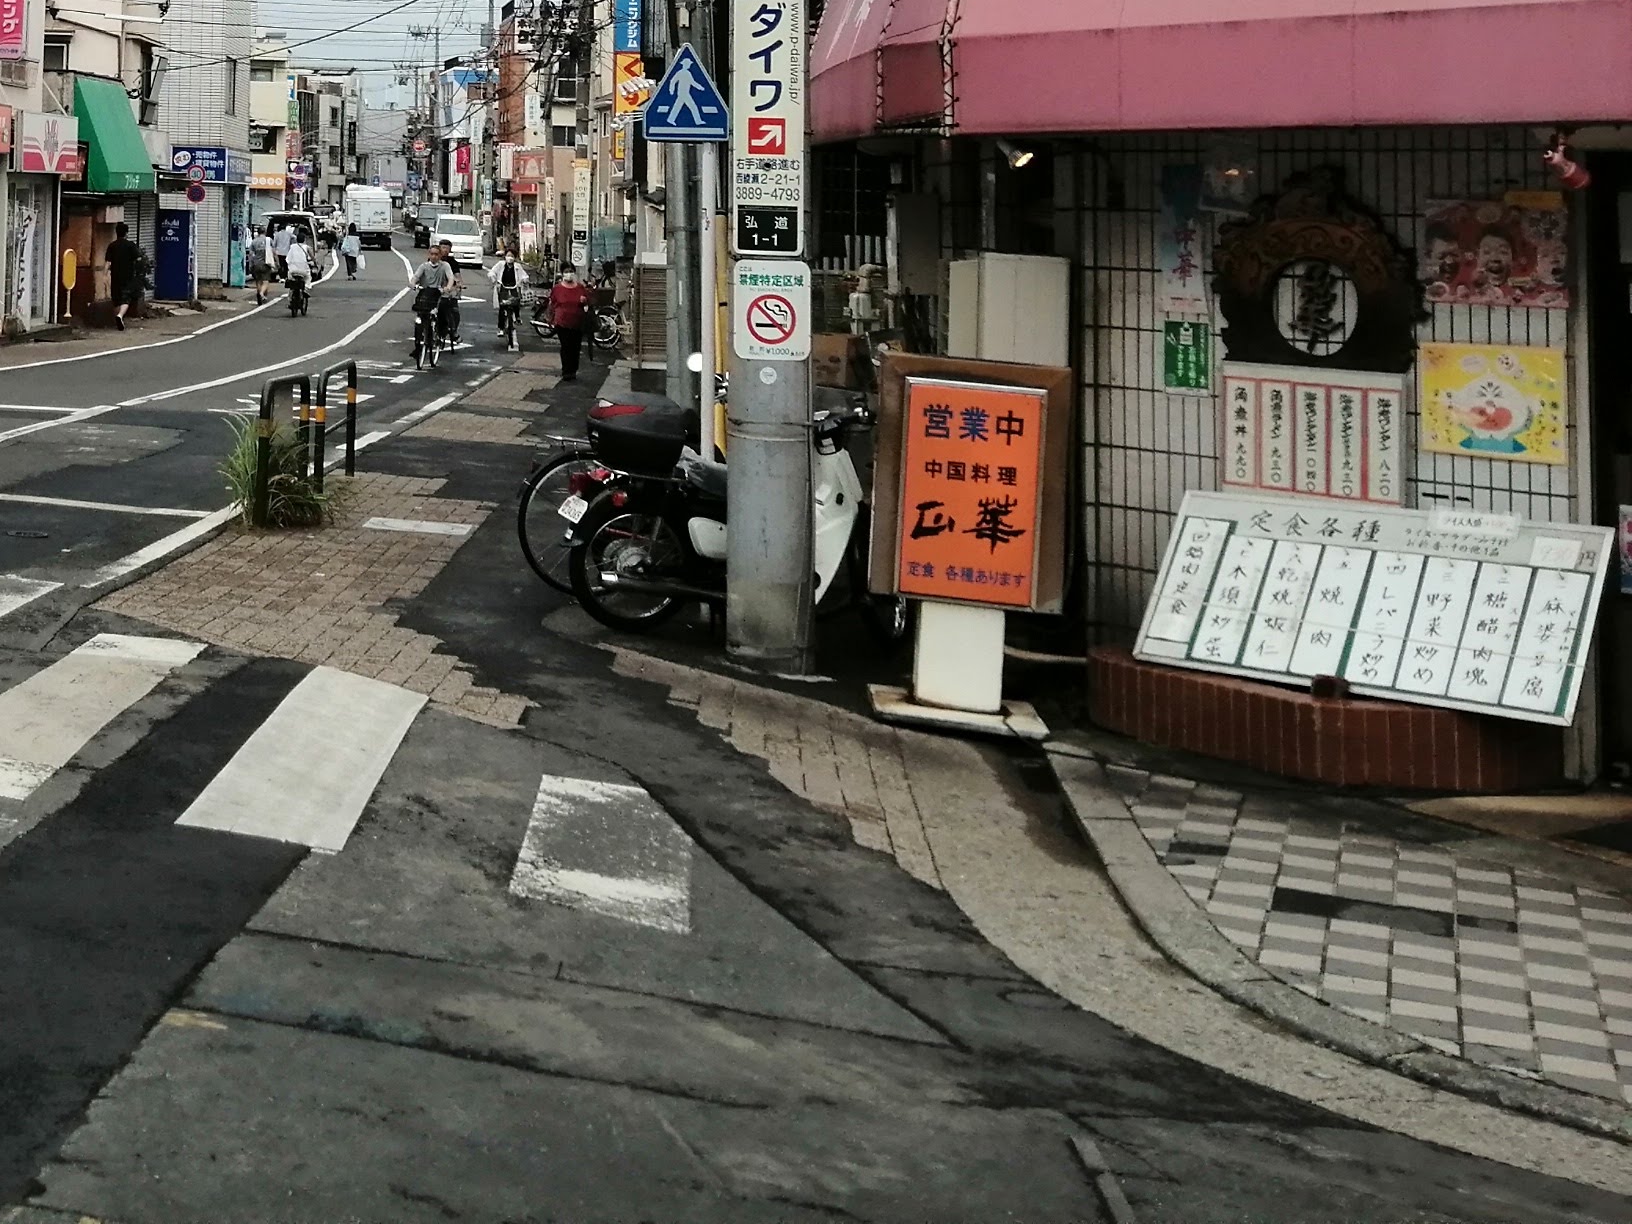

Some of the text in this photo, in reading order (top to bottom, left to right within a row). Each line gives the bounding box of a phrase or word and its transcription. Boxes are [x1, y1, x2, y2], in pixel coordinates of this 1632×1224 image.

[748, 2, 787, 113] ダイワ
[789, 2, 801, 106] www.p-daiwa.jp/
[735, 186, 801, 202] 3889-4793
[752, 233, 780, 247] 1-1
[738, 273, 805, 288] 禁煙特定区域
[923, 404, 1025, 446] 営業中
[925, 459, 1018, 487] 中国料理
[1249, 509, 1382, 544] 定食各種
[907, 561, 1025, 588] 定食 各種あります
